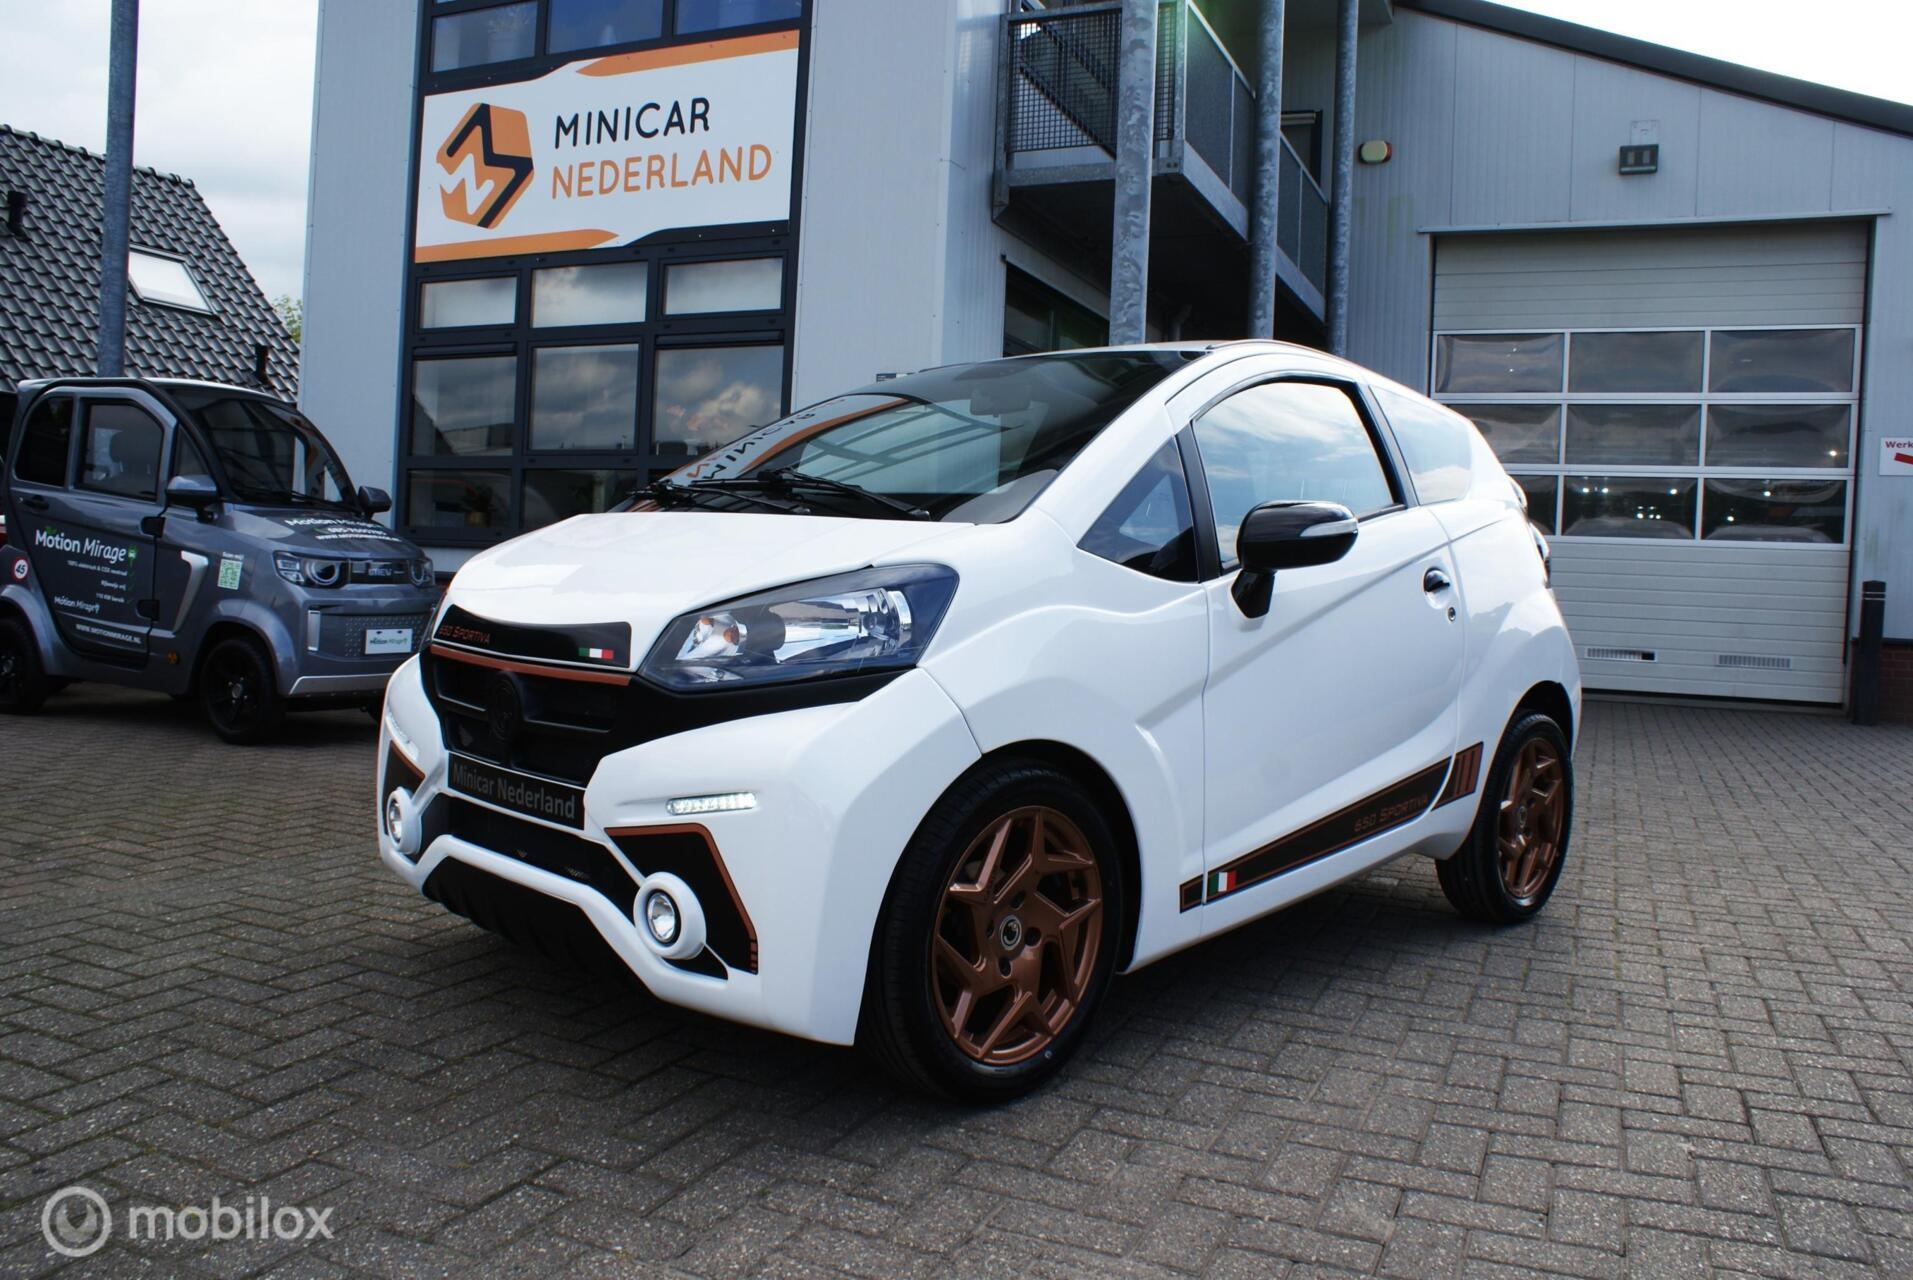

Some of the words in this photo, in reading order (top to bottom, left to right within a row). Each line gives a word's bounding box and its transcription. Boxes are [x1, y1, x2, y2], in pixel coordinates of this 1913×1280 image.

[555, 97, 710, 149] MINICAR
[552, 144, 772, 199] NEDERLAND
[16, 563, 25, 575] 45
[35, 529, 82, 554] Motion
[82, 537, 128, 565] Mirage
[453, 763, 495, 796] Minicar
[496, 777, 577, 819] Nederland
